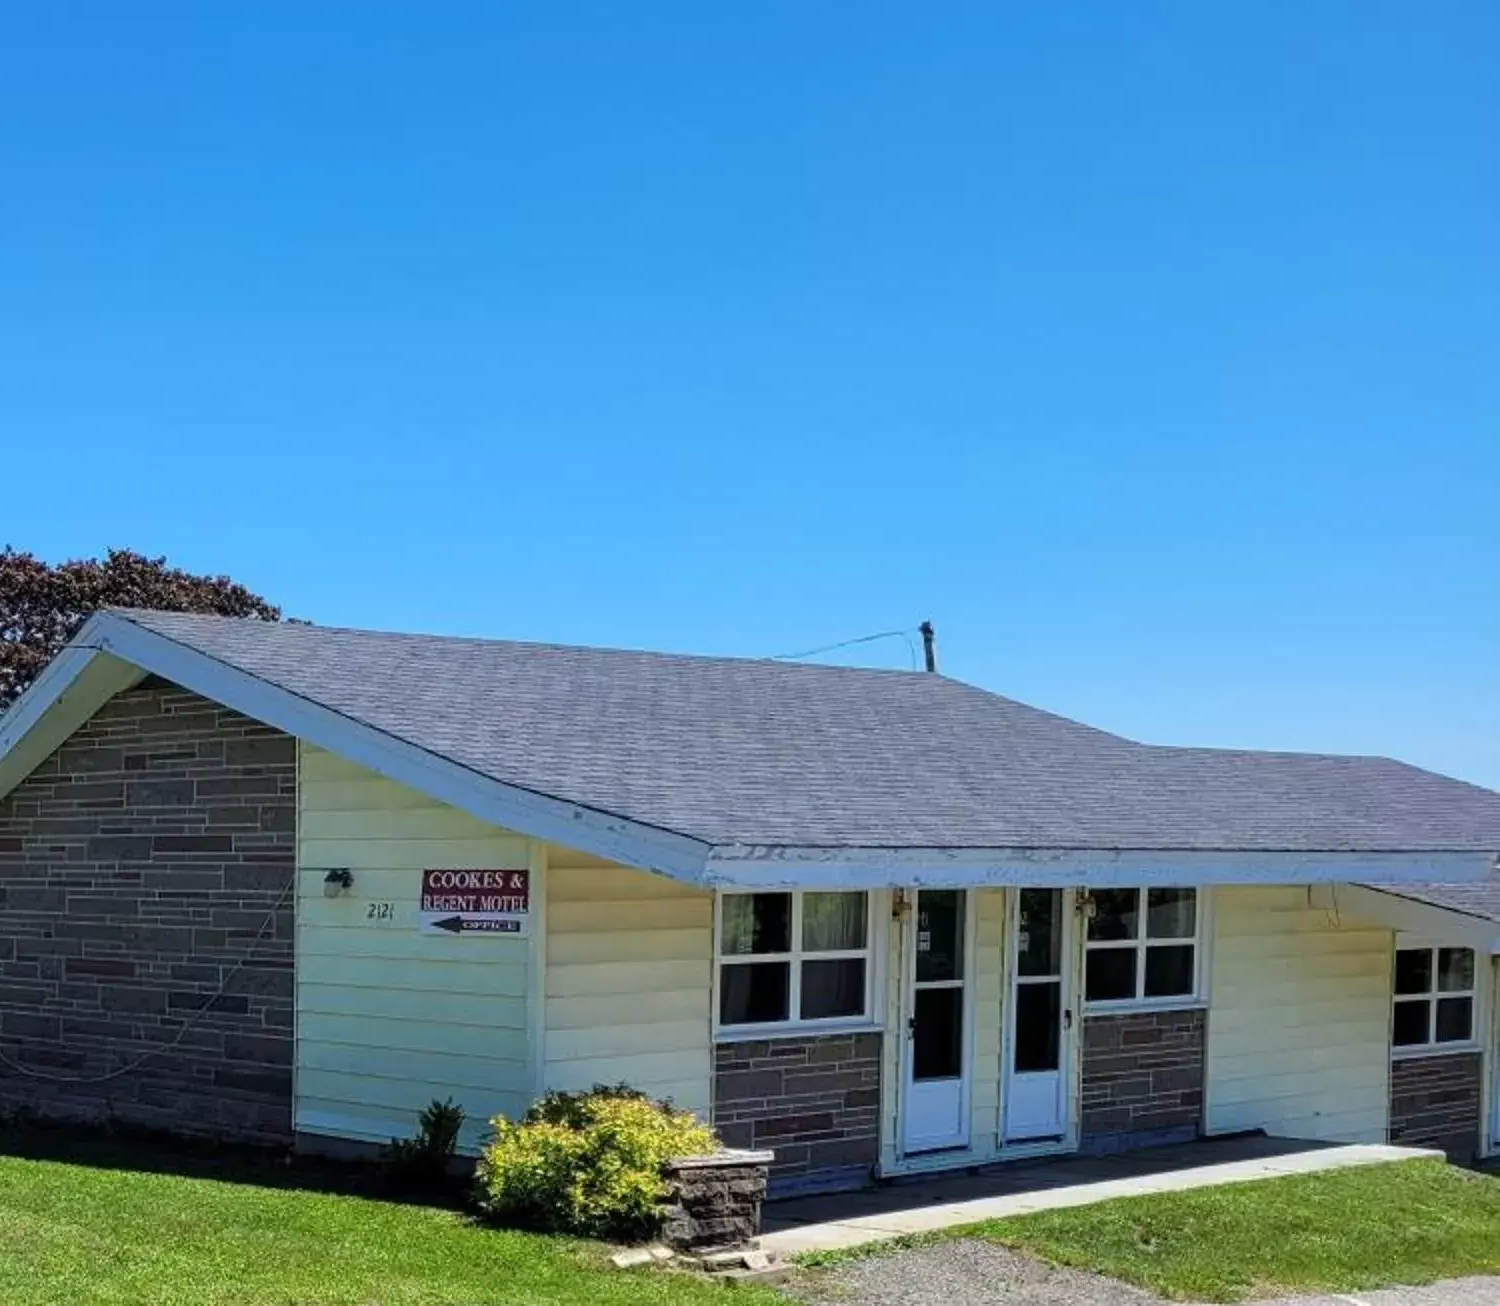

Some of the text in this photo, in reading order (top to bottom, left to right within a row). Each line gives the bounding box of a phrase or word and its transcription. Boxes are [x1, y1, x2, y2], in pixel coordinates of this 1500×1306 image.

[429, 871, 523, 889] COOKES &
[367, 903, 394, 920] 2121
[423, 894, 526, 912] REGENT MOTEL
